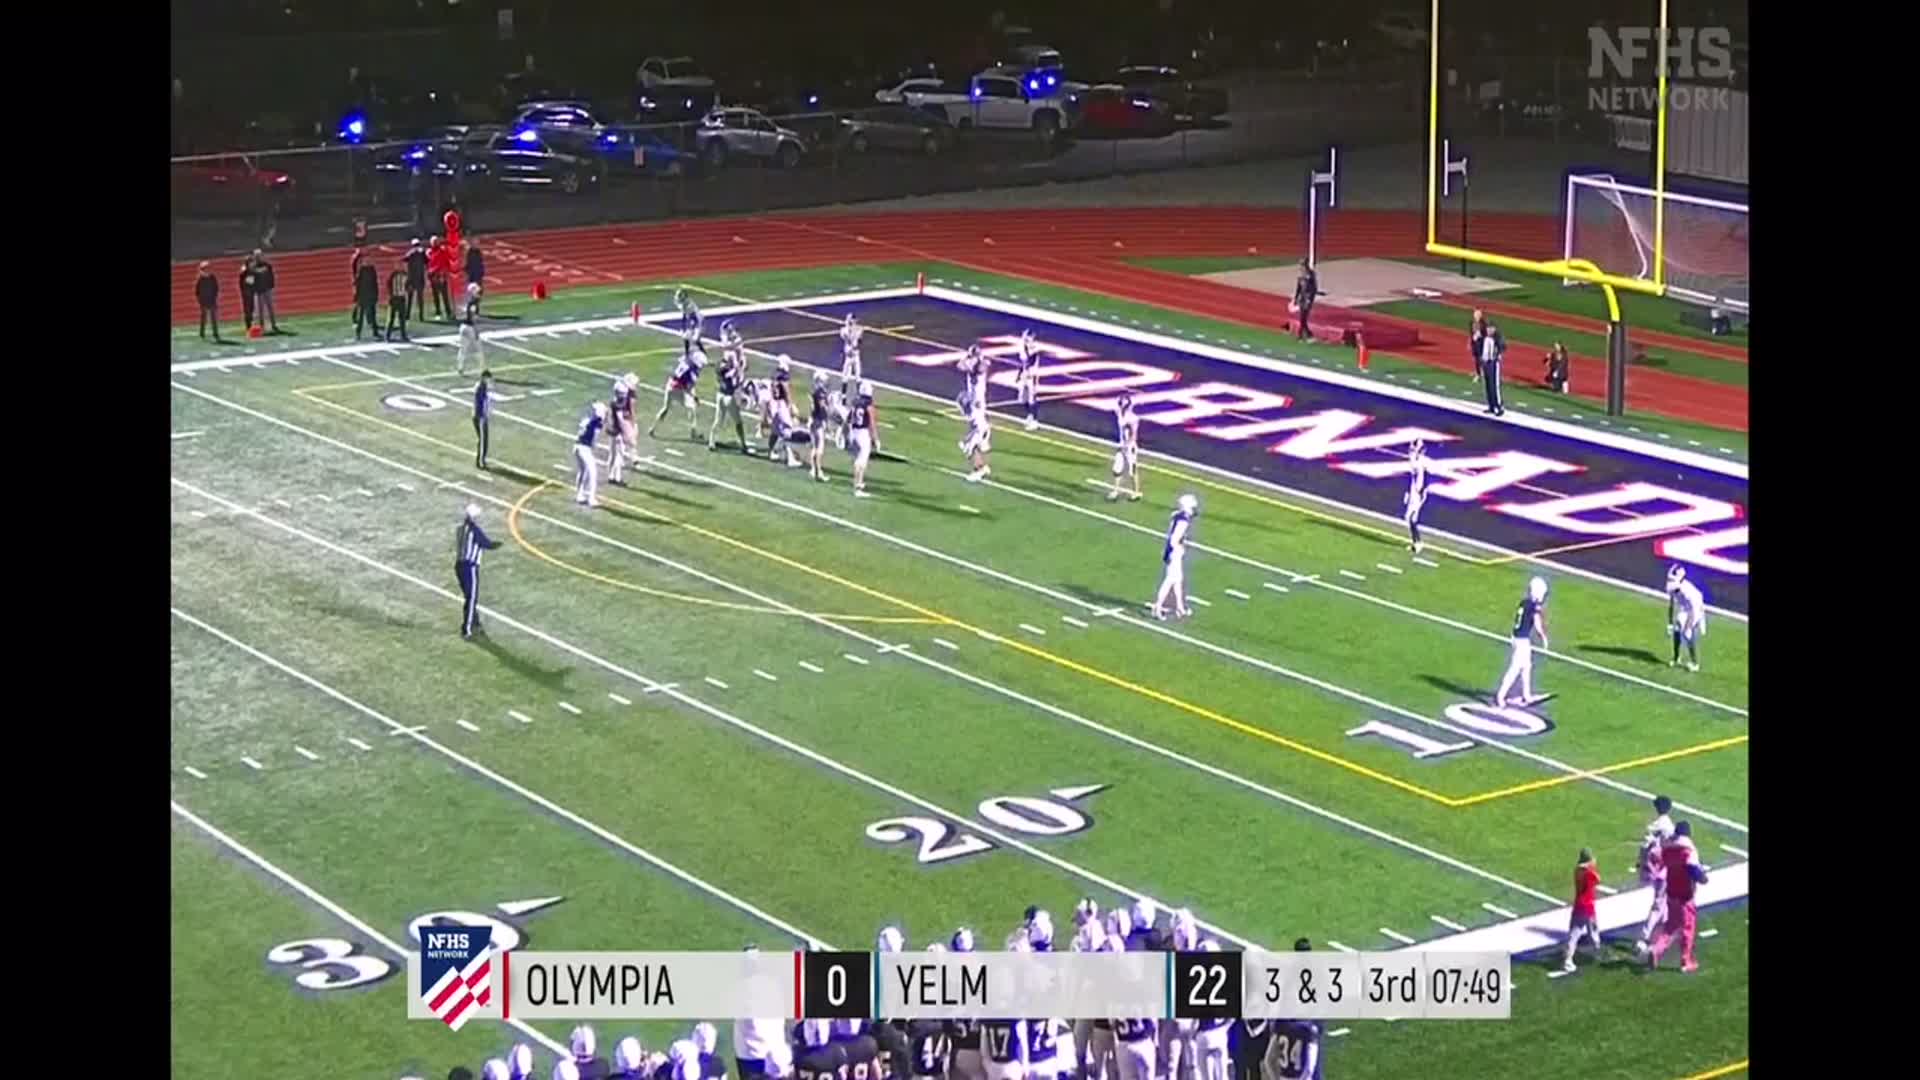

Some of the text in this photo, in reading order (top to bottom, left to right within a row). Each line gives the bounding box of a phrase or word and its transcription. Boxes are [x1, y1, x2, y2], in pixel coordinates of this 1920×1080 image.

[1345, 702, 1550, 759] 10
[865, 796, 1088, 863] 20
[989, 1027, 1010, 1058] 17
[1278, 1035, 1303, 1071] 34
